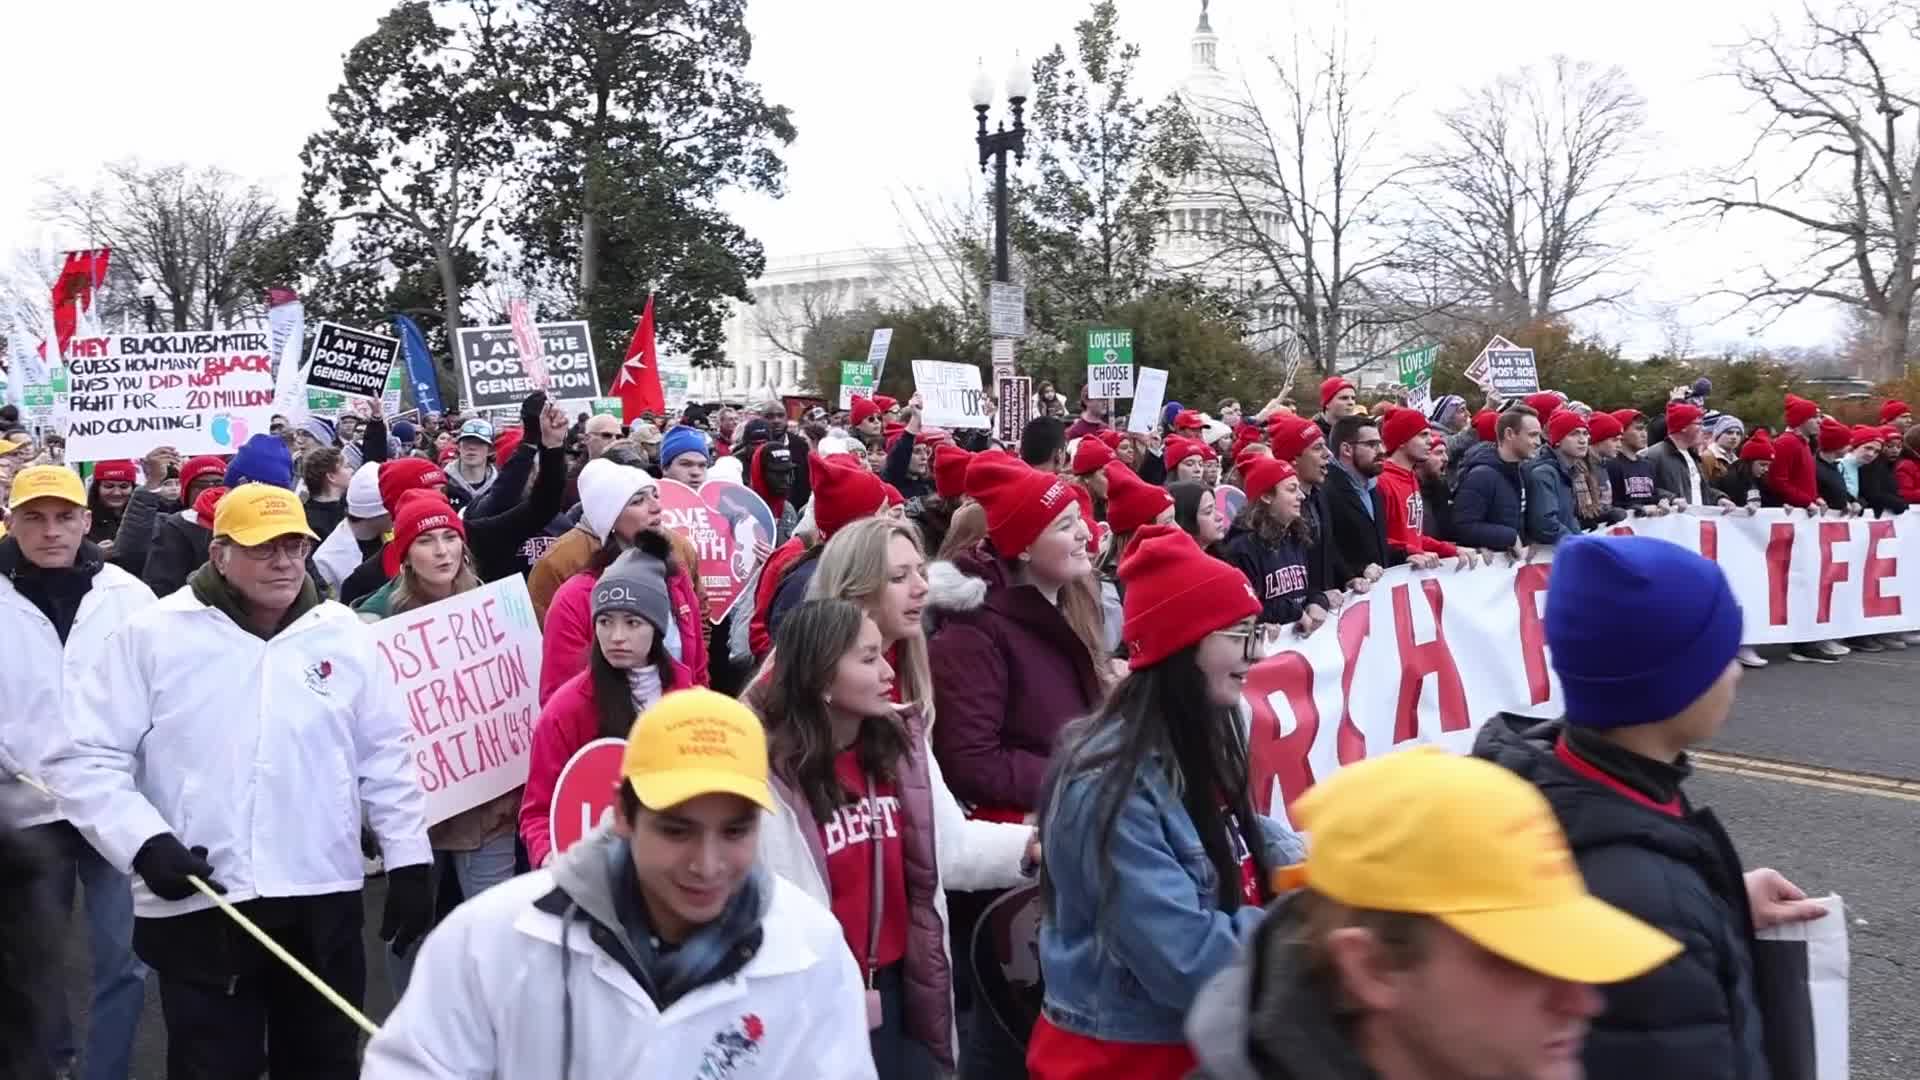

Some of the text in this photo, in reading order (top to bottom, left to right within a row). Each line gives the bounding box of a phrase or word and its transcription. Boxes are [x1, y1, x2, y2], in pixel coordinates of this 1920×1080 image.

[71, 337, 111, 357] HEY
[323, 335, 330, 346] I
[333, 338, 357, 353] AM
[363, 343, 389, 360] THE
[472, 343, 480, 356] I
[1090, 332, 1131, 348] LOVE LIFE
[70, 357, 121, 375] GUESS
[125, 358, 159, 371] HOW
[159, 356, 201, 371] MANY
[204, 355, 271, 372] BLACK
[315, 348, 391, 376] POST-ROE
[469, 352, 588, 377] POSROE
[1400, 352, 1423, 374] LOVE
[1515, 357, 1531, 365] THE
[71, 374, 221, 392] LIVES YOU DID NOT
[313, 365, 384, 389] GENERATION
[475, 372, 590, 395] GENERTION
[1093, 366, 1128, 380] CHOOSE
[1102, 382, 1120, 396] LIFE
[70, 393, 116, 411] FIGHT
[186, 391, 210, 409] 20
[68, 414, 201, 437] AND COUNTING!
[661, 508, 709, 528] OVE
[688, 538, 727, 560] TH
[598, 587, 637, 603] COL
[377, 598, 504, 684] OST-ROE
[407, 644, 529, 736] NERATION
[1244, 578, 1471, 834] RCH
[416, 718, 505, 792] SAIAH
[824, 796, 901, 856] BET
